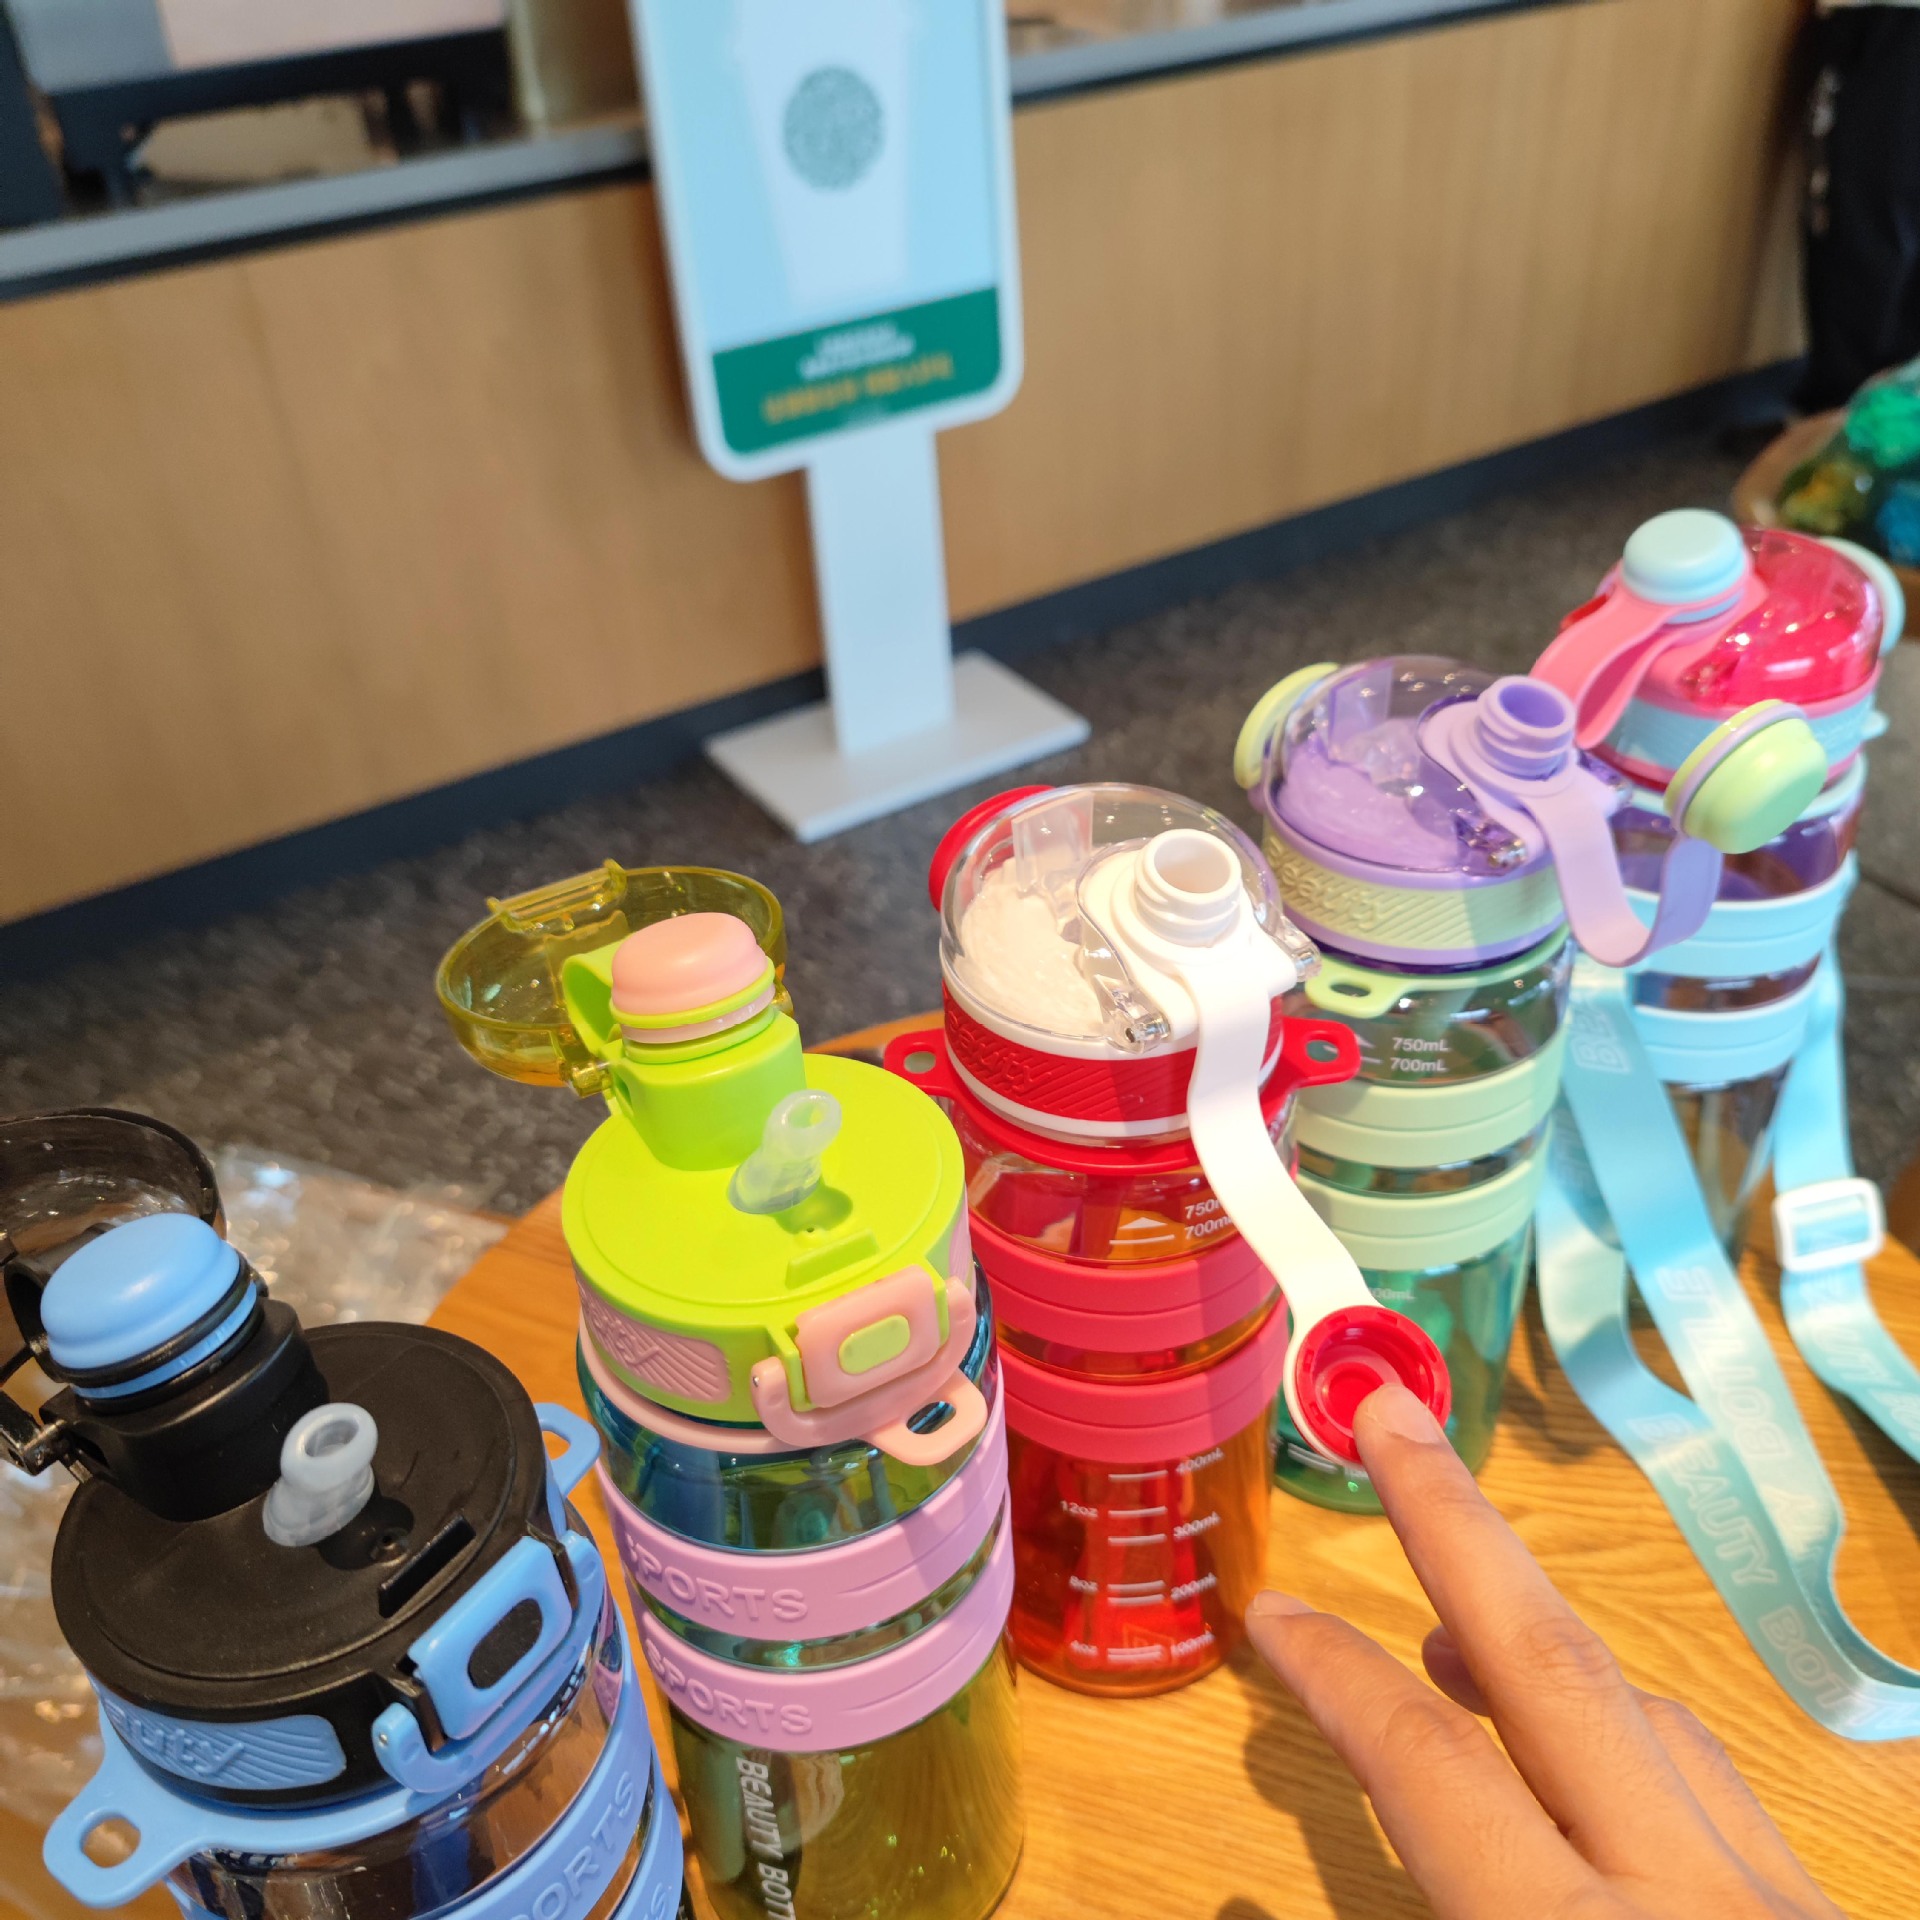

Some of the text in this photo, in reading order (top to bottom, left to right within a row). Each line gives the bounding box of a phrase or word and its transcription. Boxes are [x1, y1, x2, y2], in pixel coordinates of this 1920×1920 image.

[1391, 1037, 1450, 1053] 750mL
[1389, 1057, 1447, 1073] 700mL
[1184, 1198, 1221, 1220] 750
[1184, 1216, 1233, 1241] 700m
[1626, 1412, 1780, 1587] BEAUTY
[646, 1638, 813, 1735] SPORTS
[736, 1757, 797, 1920] BEAUTY BOTT
